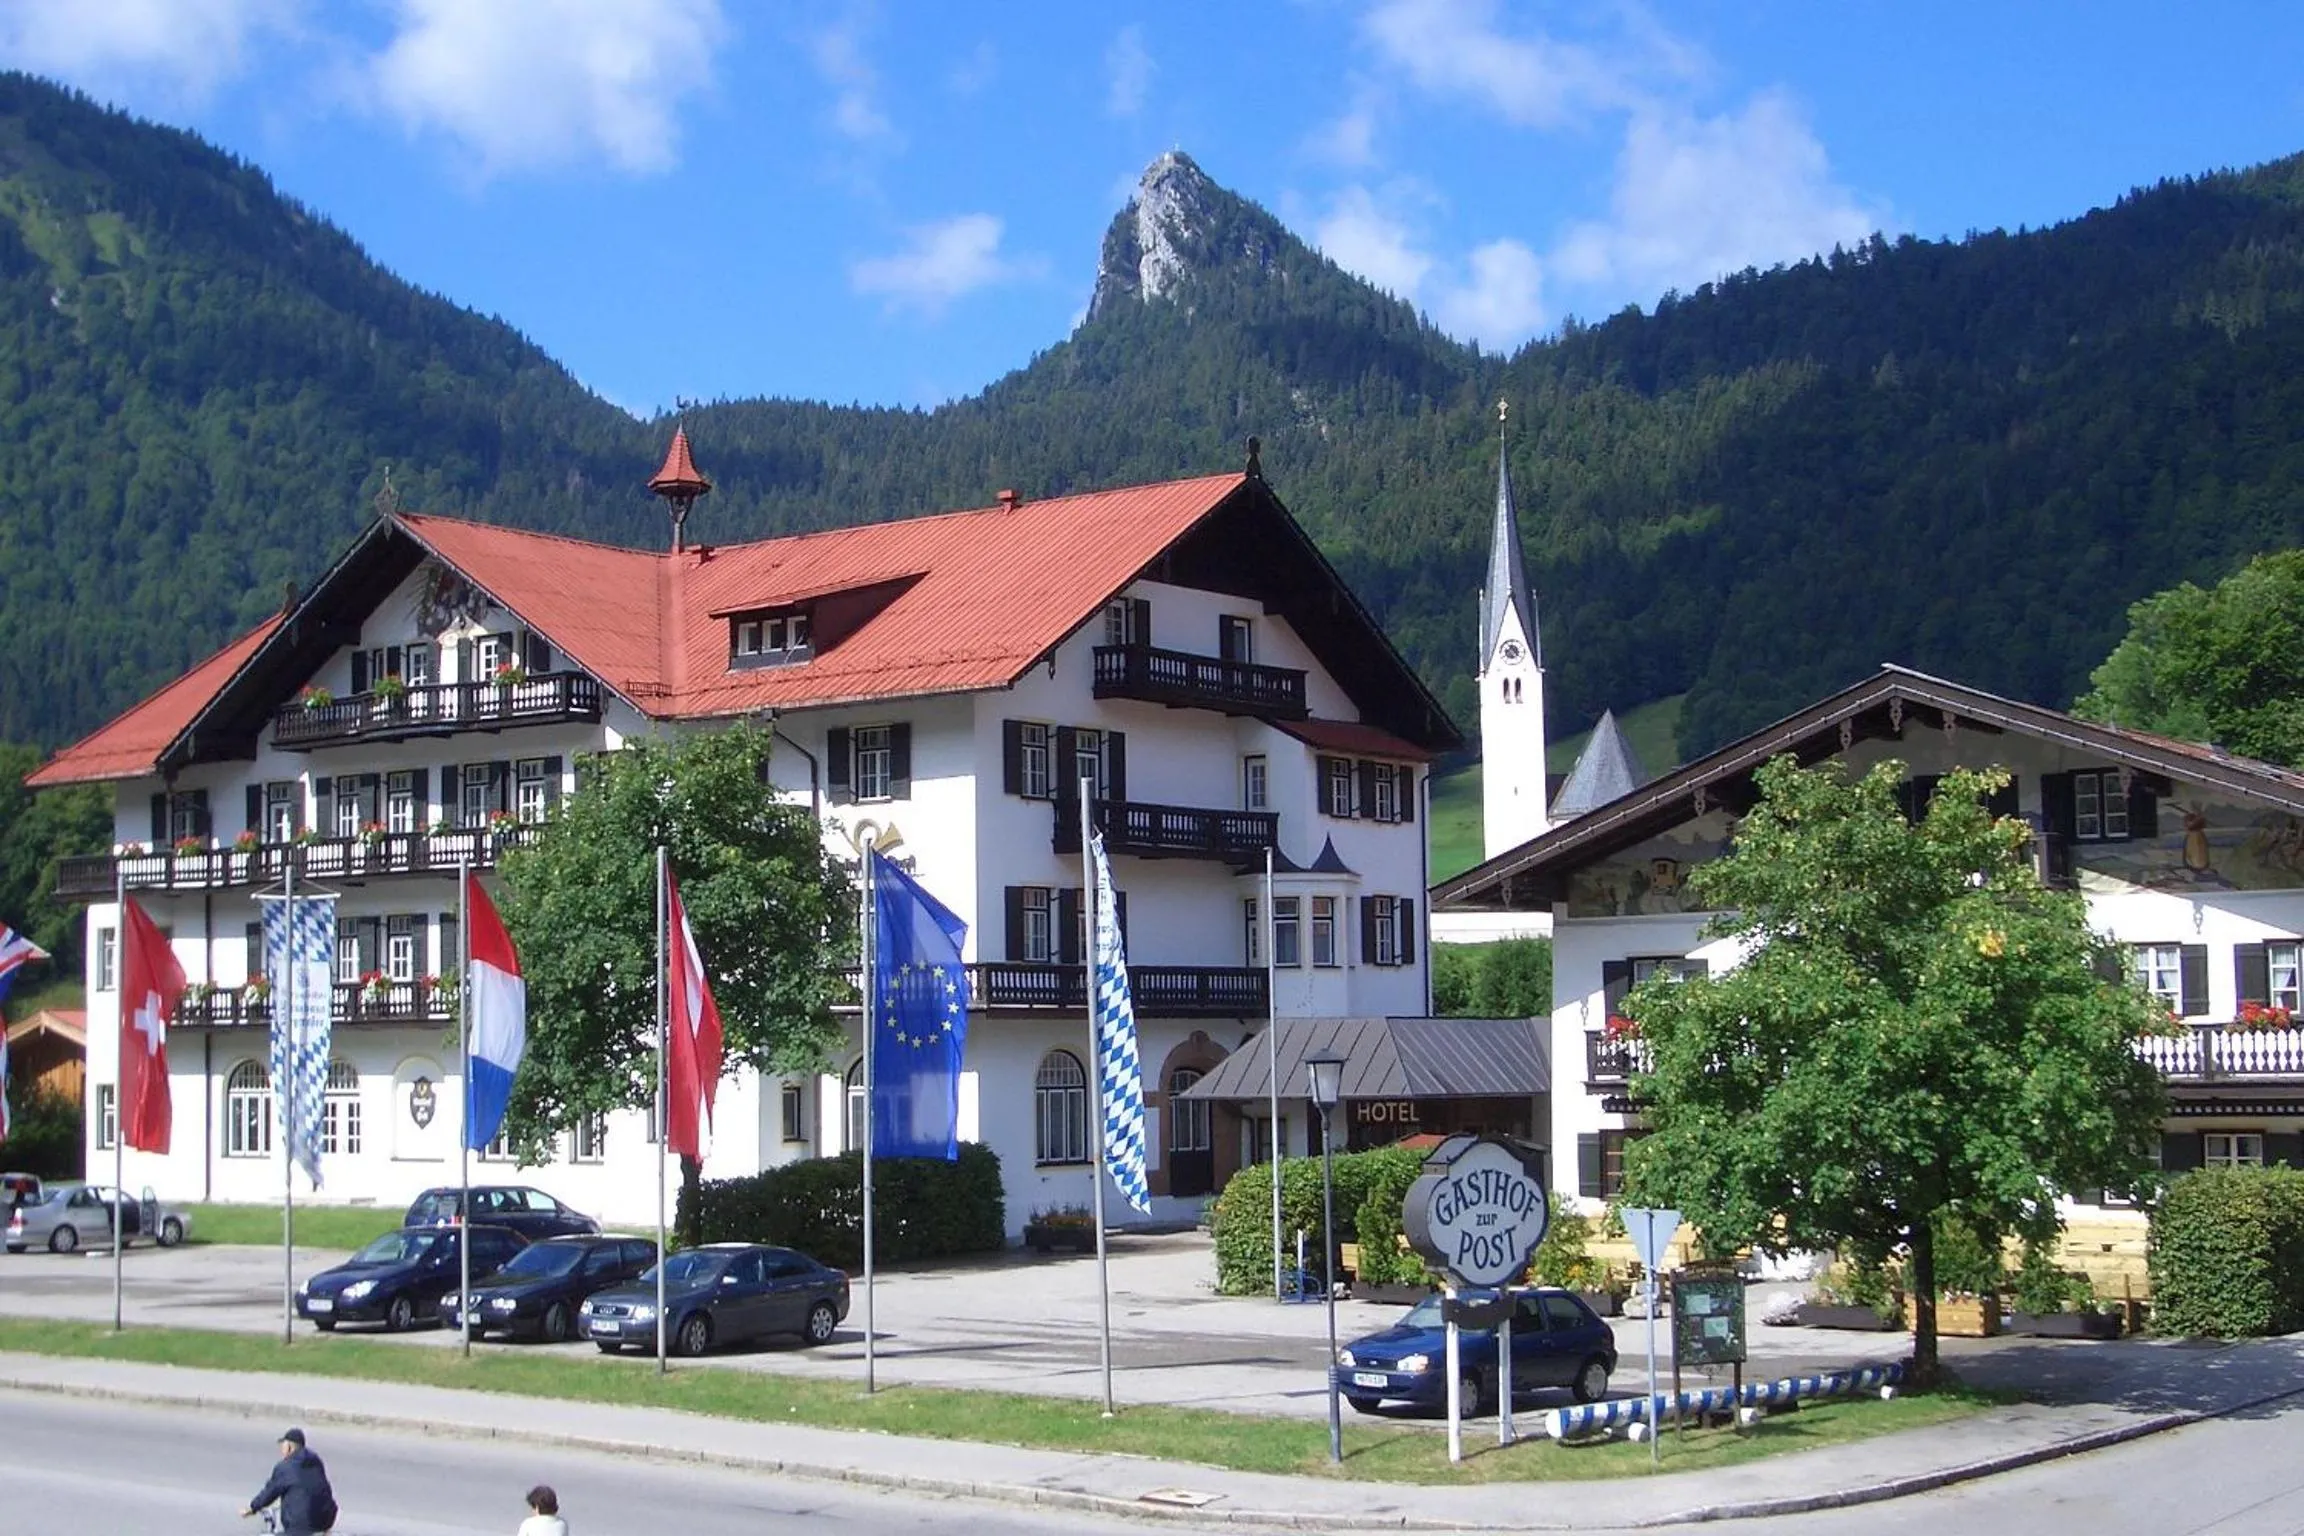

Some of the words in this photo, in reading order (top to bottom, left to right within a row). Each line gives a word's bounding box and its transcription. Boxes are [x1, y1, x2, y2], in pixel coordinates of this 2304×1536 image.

[1357, 1102, 1420, 1122] HOTEL
[1435, 1168, 1541, 1226] GASTHOF
[1457, 1225, 1518, 1270] POST
